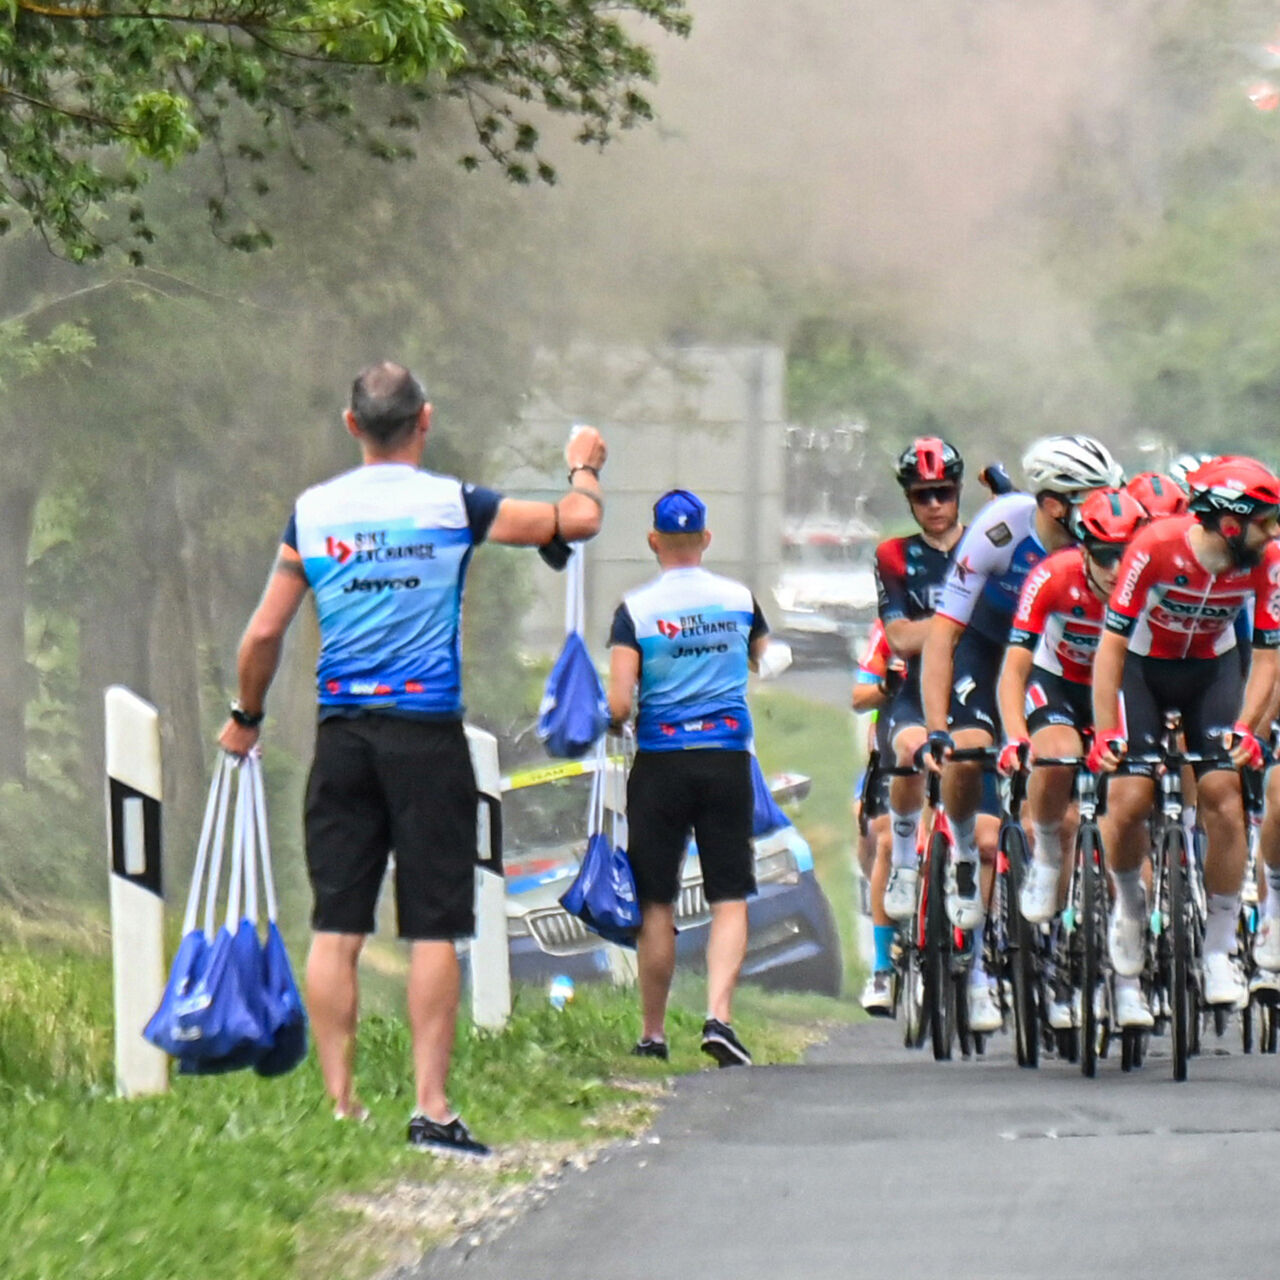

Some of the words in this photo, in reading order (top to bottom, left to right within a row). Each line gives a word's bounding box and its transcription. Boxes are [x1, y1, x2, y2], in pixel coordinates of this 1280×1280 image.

[1117, 551, 1151, 608] SOUDAL
[1017, 567, 1052, 623] SOUDAL
[680, 613, 705, 628] BIKE
[682, 621, 739, 638] EXCHANGE
[672, 643, 729, 659] Jayco
